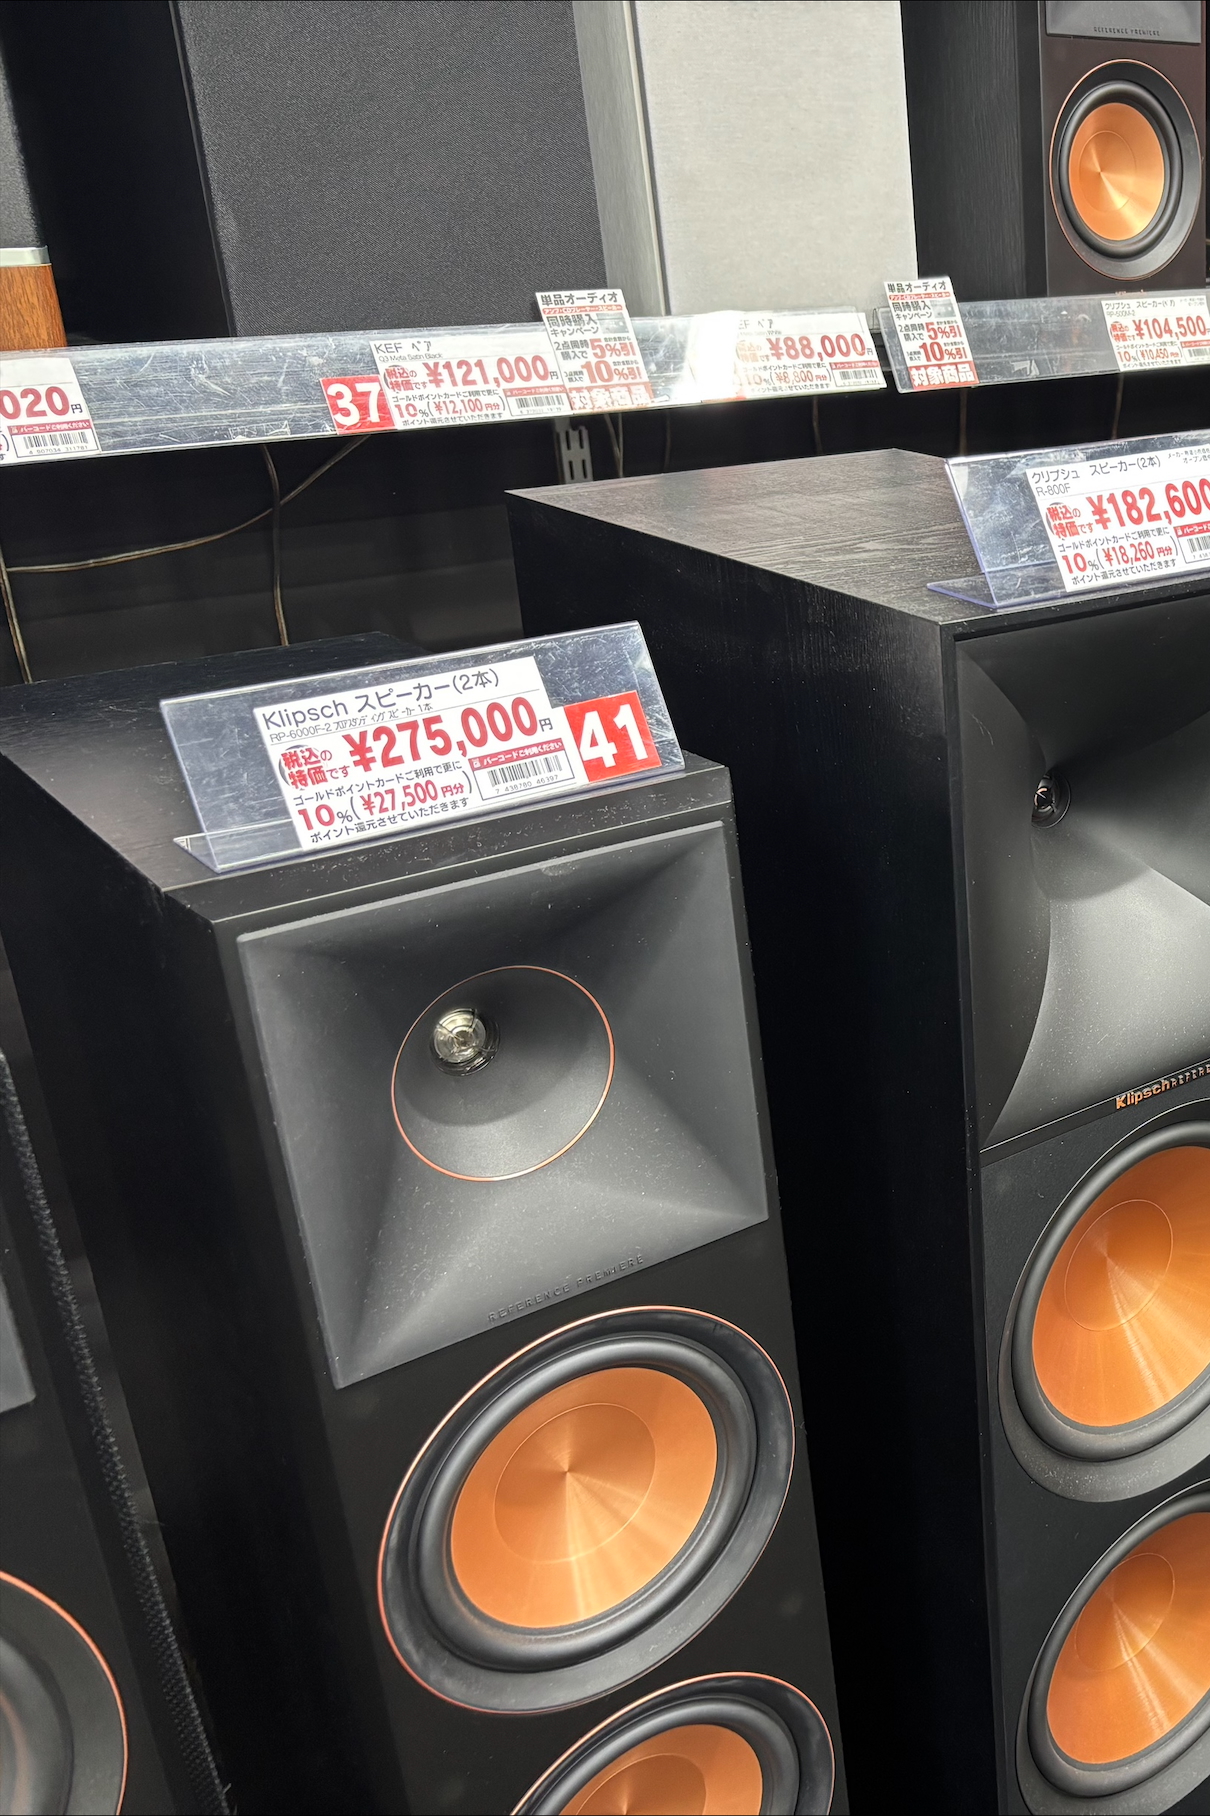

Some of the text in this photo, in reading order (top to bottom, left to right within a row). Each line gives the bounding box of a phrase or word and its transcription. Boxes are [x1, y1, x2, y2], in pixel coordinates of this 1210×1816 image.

[540, 292, 618, 307] 単品オーディオ
[887, 281, 946, 293] 単品オーディオ
[895, 311, 932, 320] キャンペーン
[550, 326, 599, 337] キャンペーン
[374, 342, 403, 354] KEF
[327, 382, 381, 427] 37
[1031, 455, 1161, 484] クリプシュ スピーカー(2本)
[1035, 483, 1071, 497] R-800F
[1046, 505, 1081, 522] 税込の
[1053, 521, 1093, 538] 特価です
[1057, 526, 1170, 553] ゴールドポイントカードご利用で更に
[1072, 558, 1176, 585] ポイント還元させていただきます
[262, 668, 500, 730] Klipsch スピーカー(2本)
[269, 722, 333, 743] RP-6000F-2
[579, 703, 649, 769] 41
[281, 747, 333, 770] 税込の
[288, 764, 350, 790] 特価です
[293, 760, 462, 807] ゴールドポイントカードご利用で更に
[310, 797, 470, 844] ポイント還元させていただきます
[1115, 1079, 1171, 1109] Klipsch
[487, 1253, 645, 1323] REFERENCE PREMIERE
